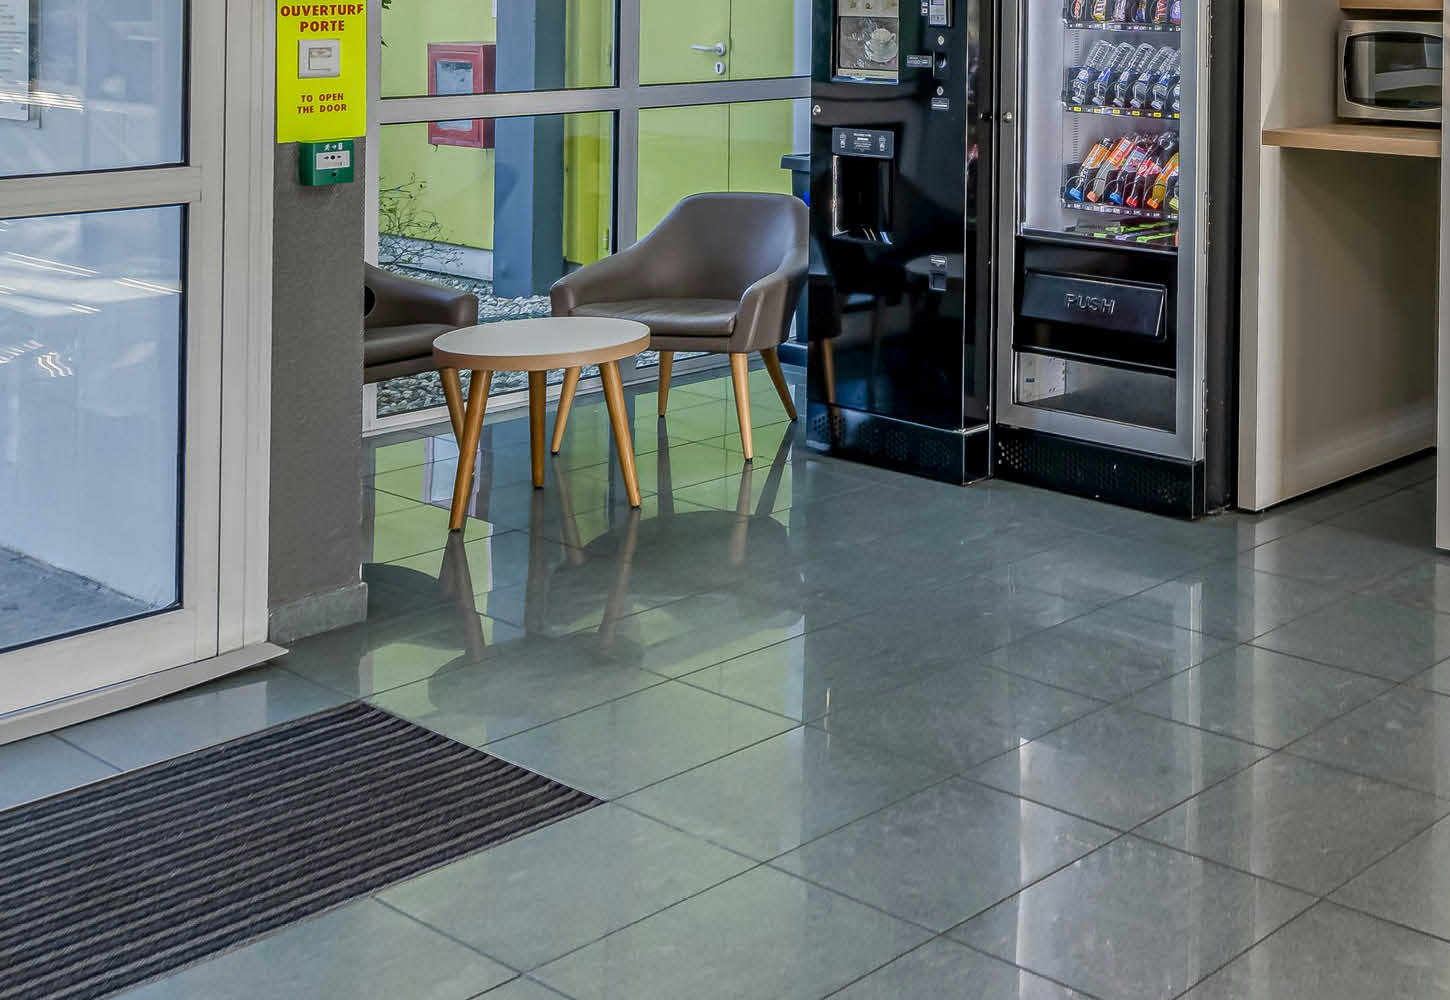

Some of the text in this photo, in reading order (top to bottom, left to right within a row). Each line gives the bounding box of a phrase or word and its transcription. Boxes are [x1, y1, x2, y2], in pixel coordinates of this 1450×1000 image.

[300, 20, 345, 32] PORTE
[301, 92, 344, 103] TO OPEN
[297, 103, 347, 114] THE DOOR
[1065, 292, 1116, 315] PUSH
